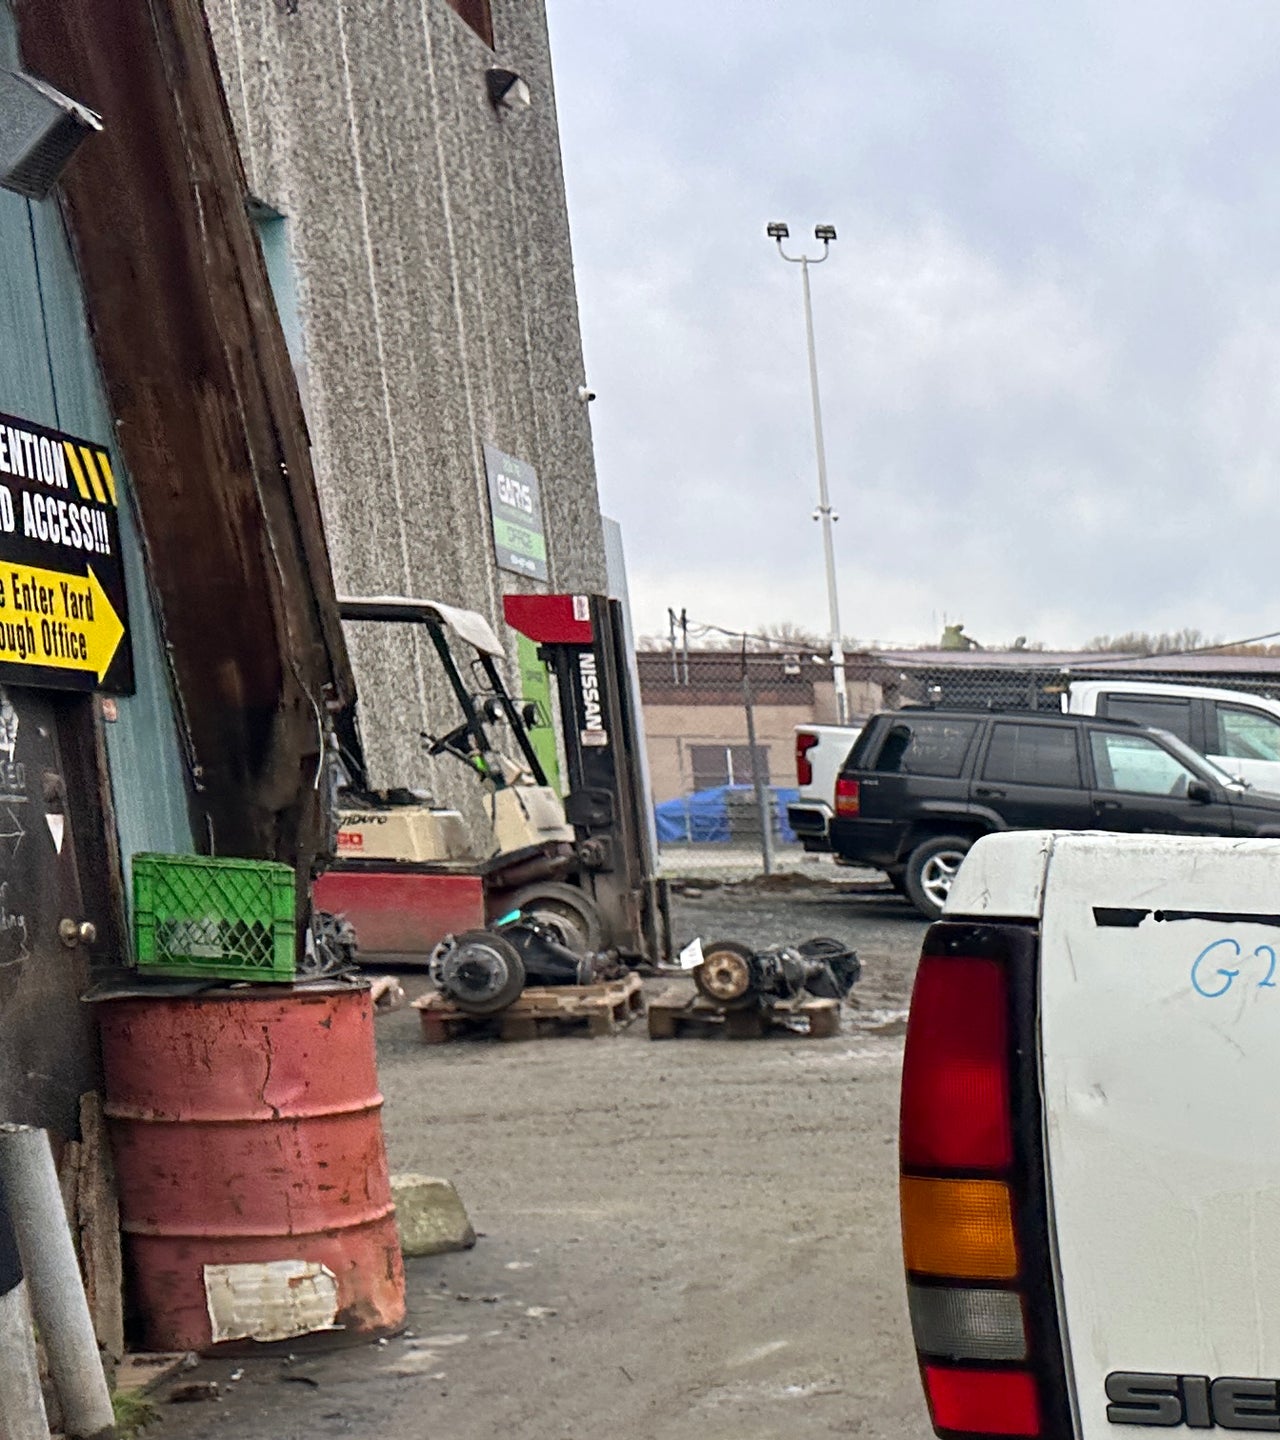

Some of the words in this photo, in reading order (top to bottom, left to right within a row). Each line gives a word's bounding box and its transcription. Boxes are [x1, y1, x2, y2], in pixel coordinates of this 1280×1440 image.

[23, 490, 110, 555] ACCESS!!!
[11, 572, 54, 616] Enter
[60, 581, 95, 622] Yard
[41, 618, 88, 661] Office
[579, 653, 603, 731] NISSAN
